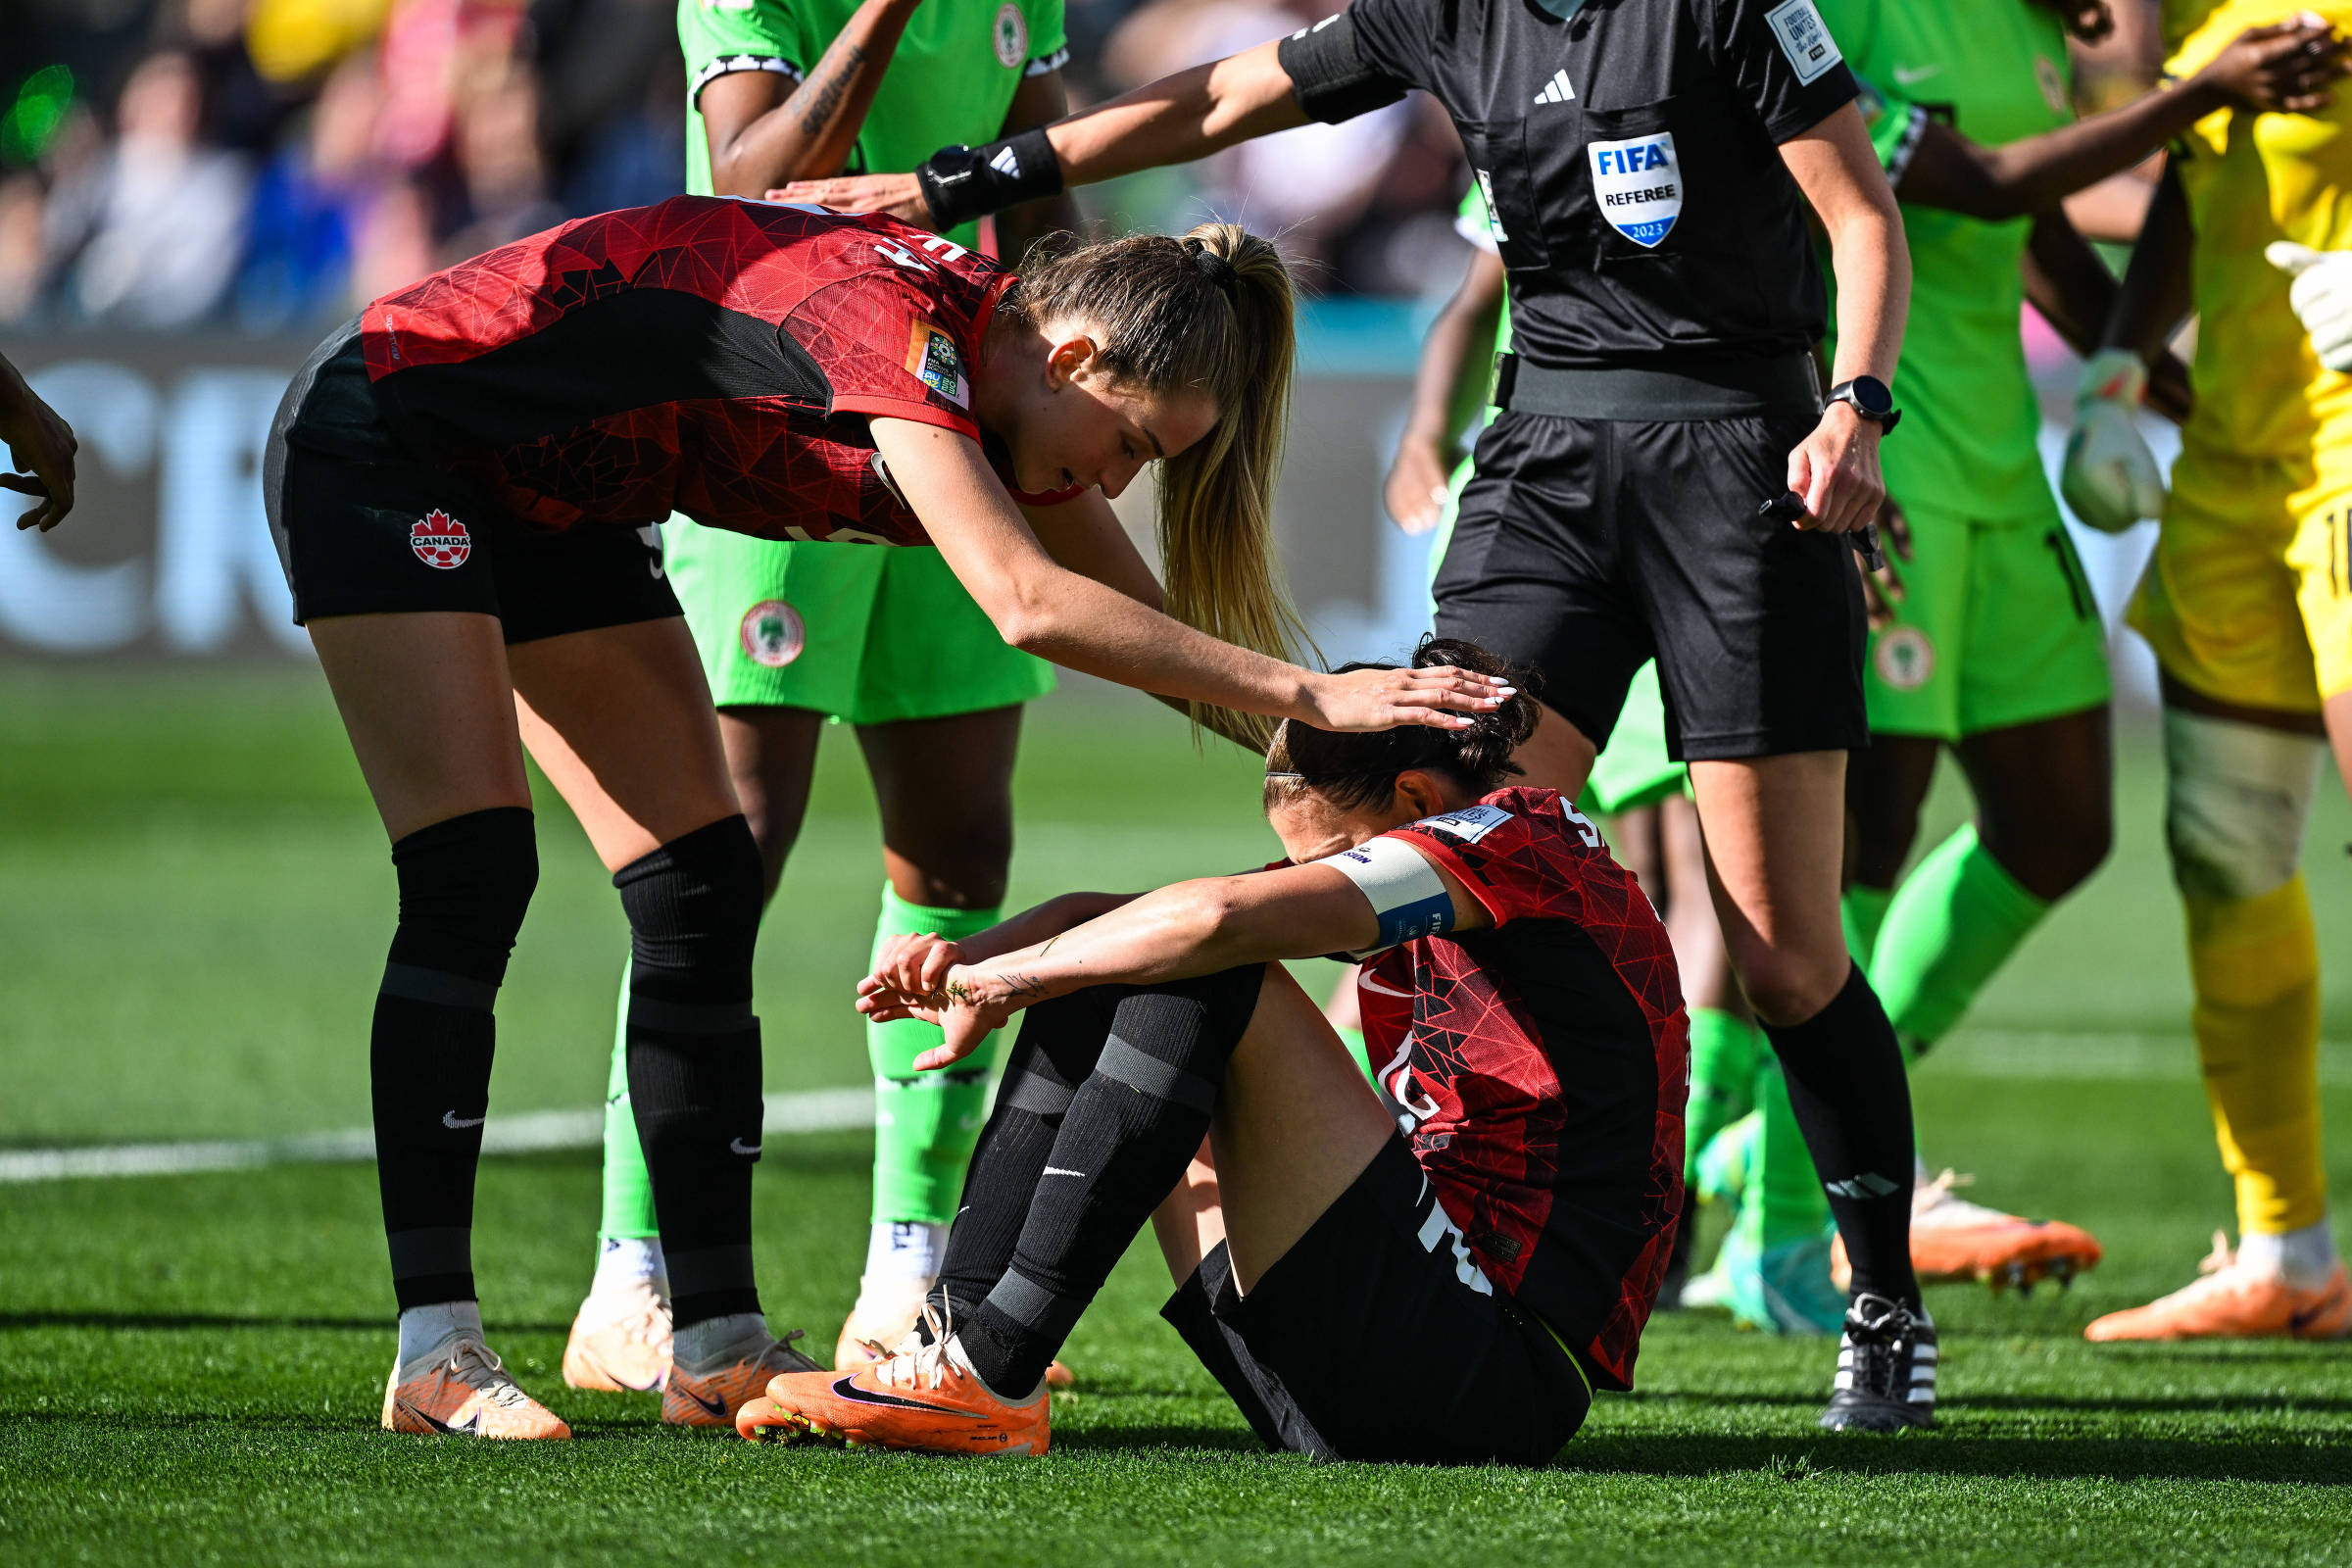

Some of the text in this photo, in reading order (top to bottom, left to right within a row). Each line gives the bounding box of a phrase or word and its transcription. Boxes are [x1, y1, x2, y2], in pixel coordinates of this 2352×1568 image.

[1788, 15, 1817, 40] UNITES
[1597, 143, 1669, 175] FIFA
[1605, 183, 1677, 207] REFEREE
[1632, 222, 1664, 238] 2023
[412, 536, 469, 547] CANADA
